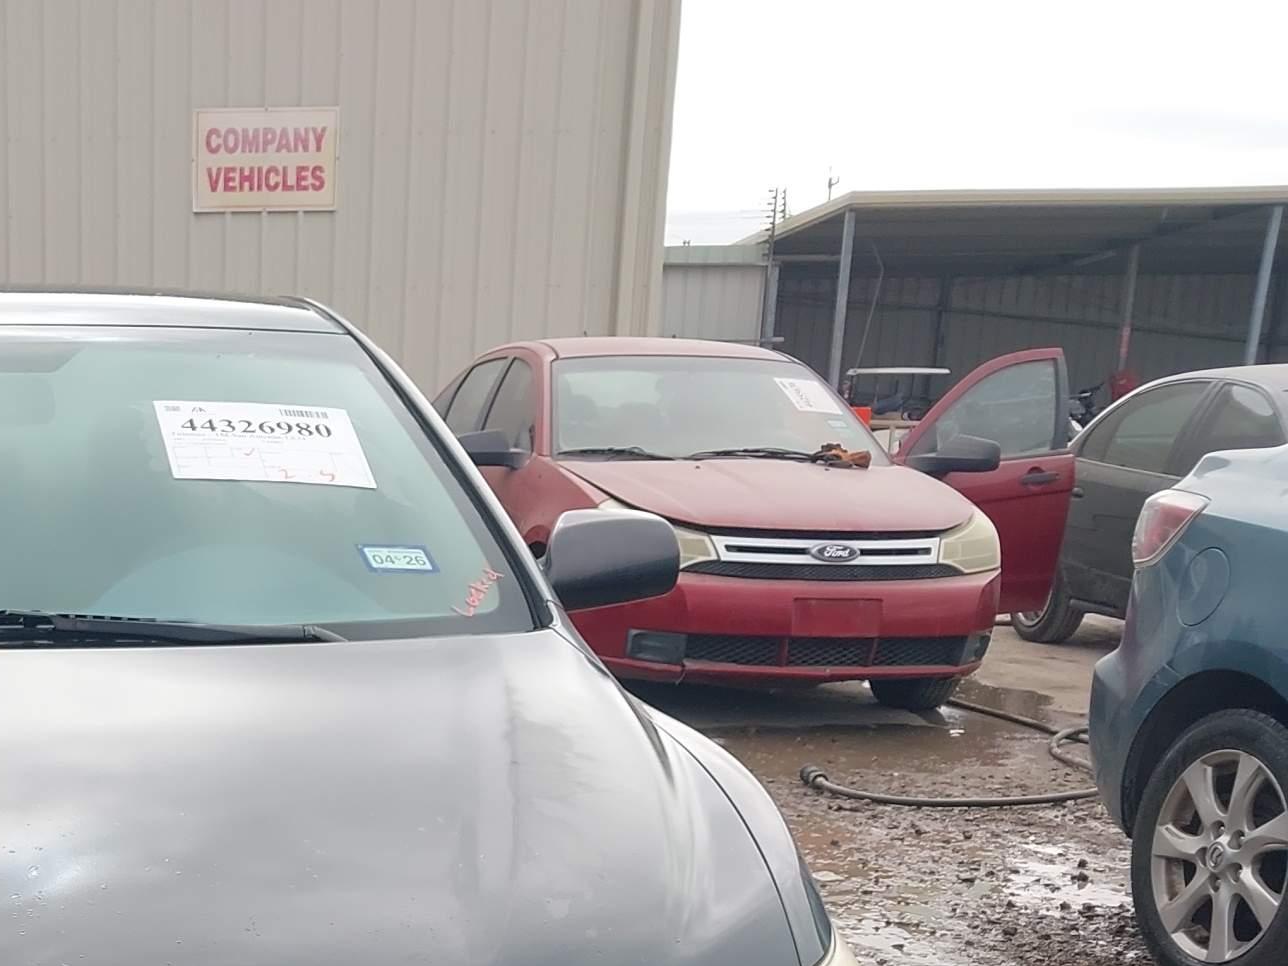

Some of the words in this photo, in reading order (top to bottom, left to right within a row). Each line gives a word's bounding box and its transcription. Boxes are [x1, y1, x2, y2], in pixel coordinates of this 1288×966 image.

[205, 126, 328, 154] COMPANY
[206, 165, 326, 193] VEHICLES
[181, 417, 333, 438] 44326980
[824, 545, 850, 557] Ford
